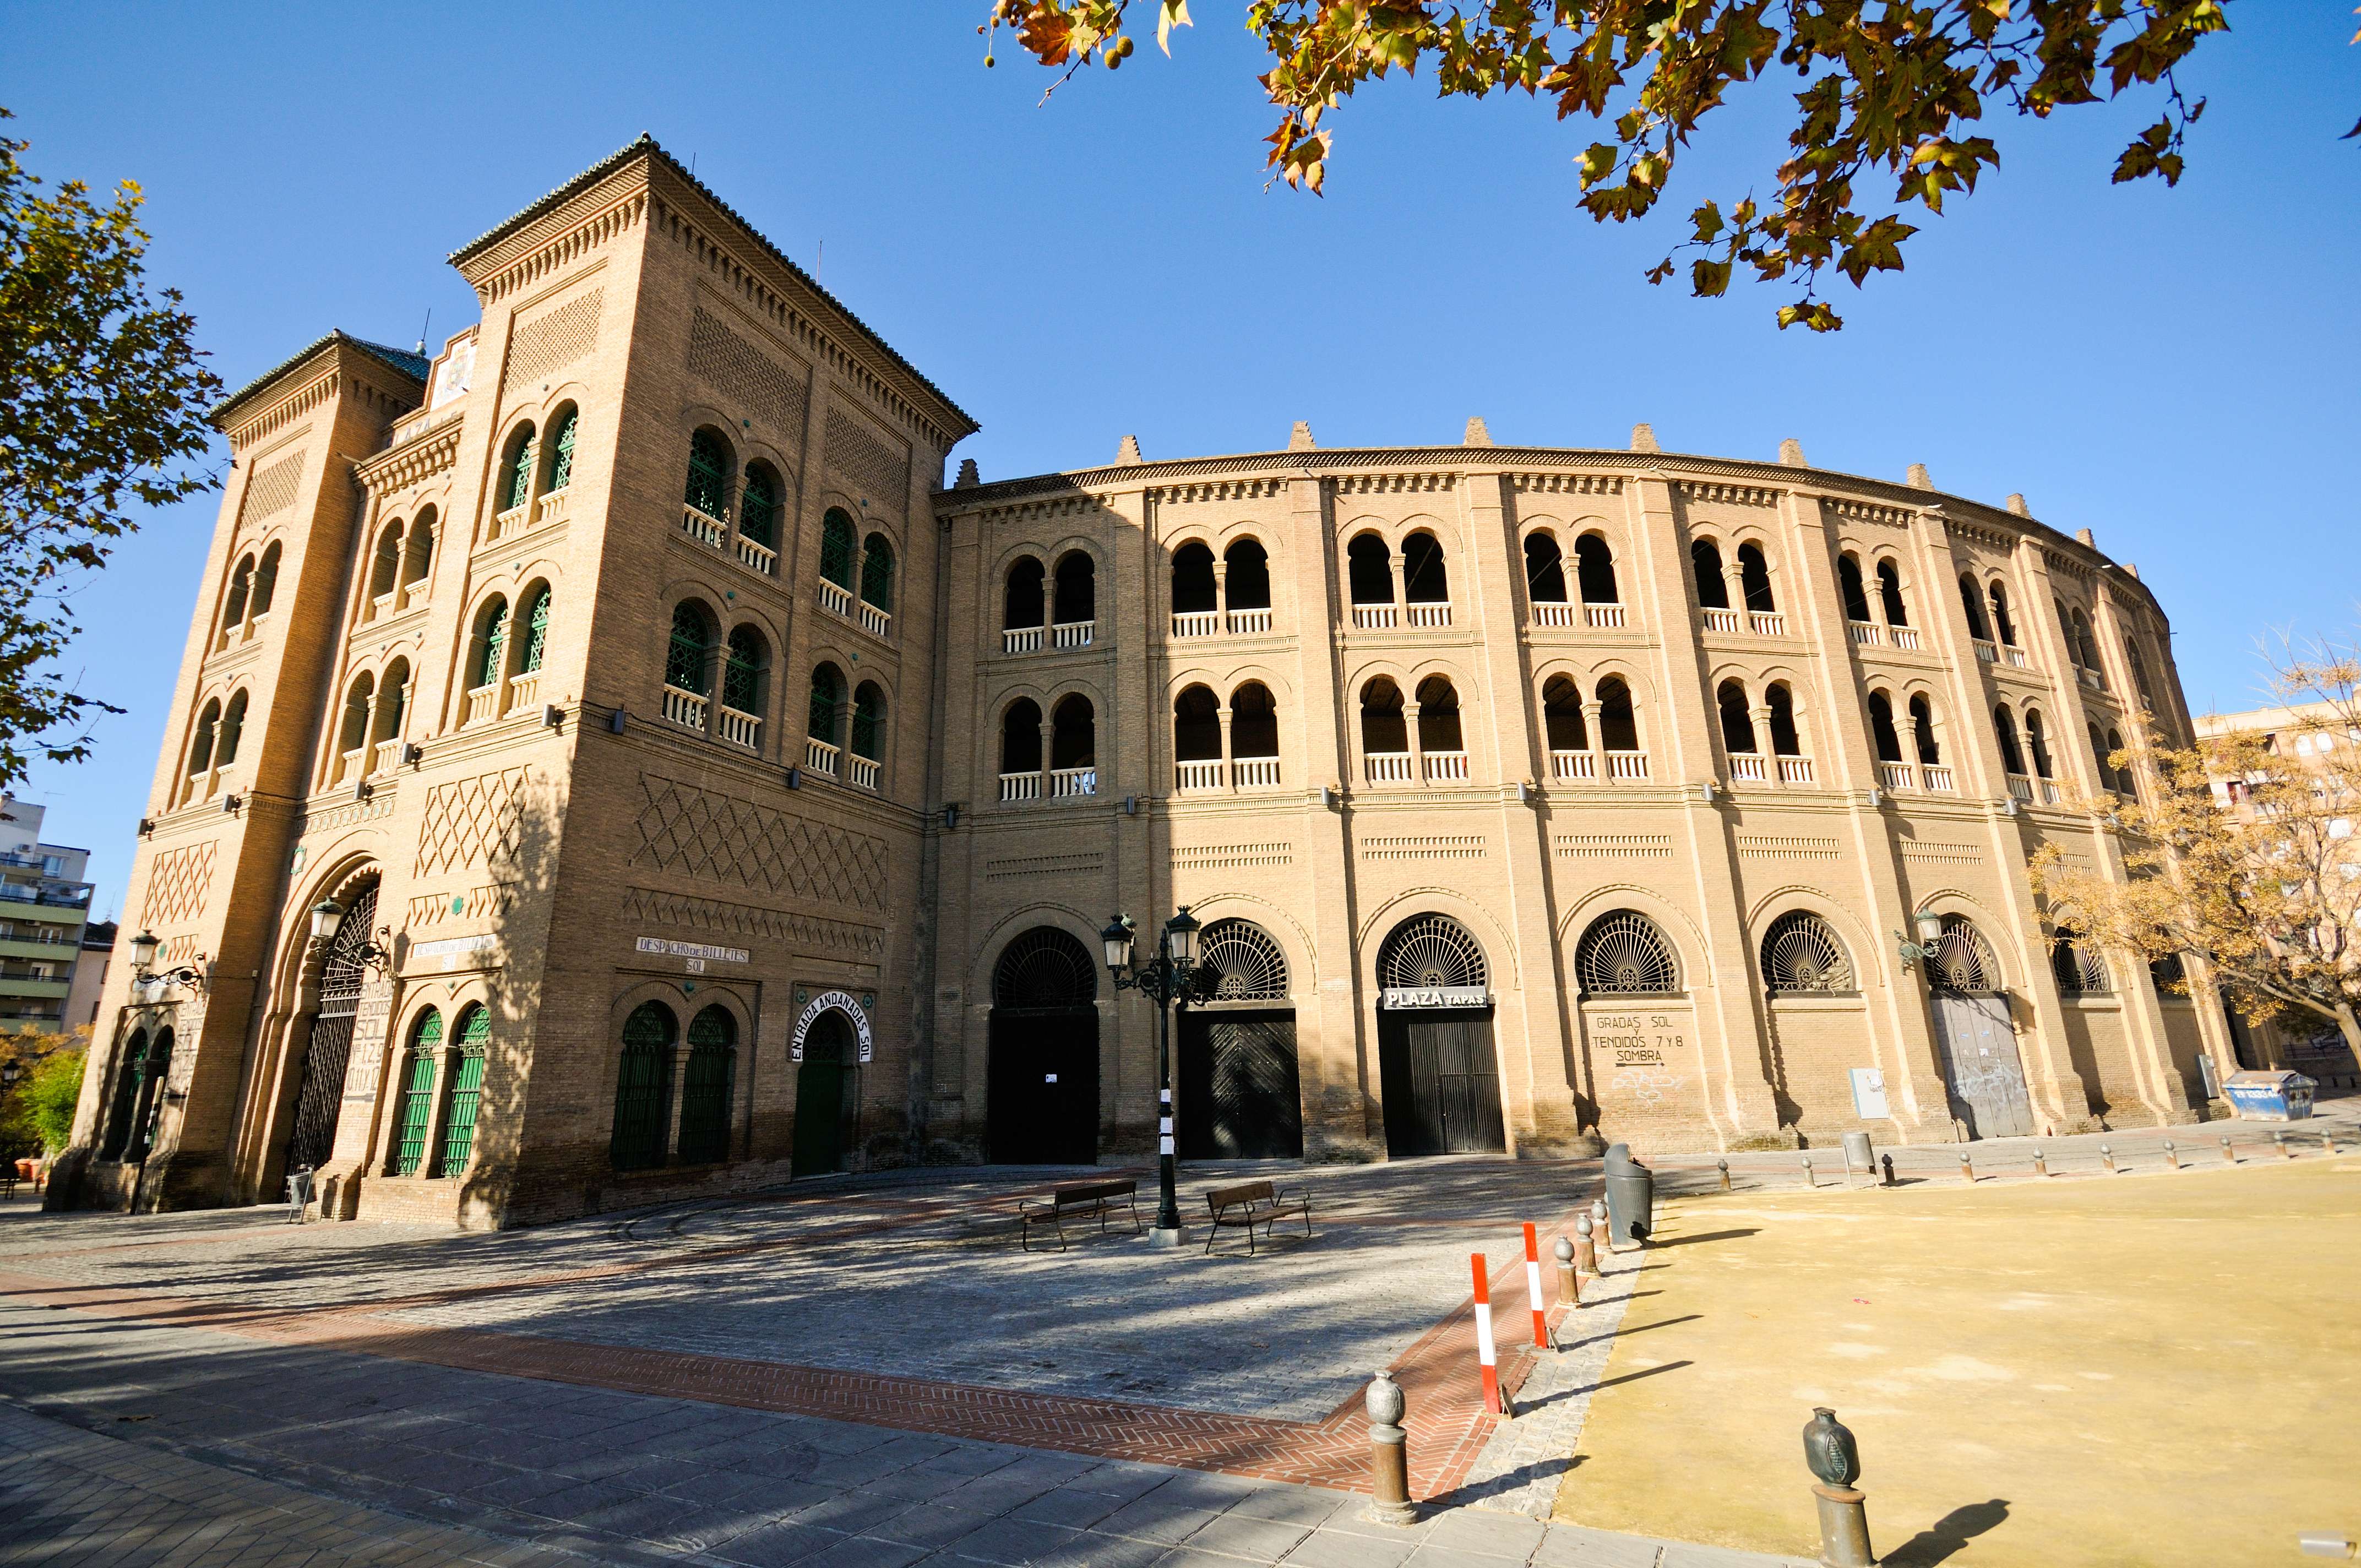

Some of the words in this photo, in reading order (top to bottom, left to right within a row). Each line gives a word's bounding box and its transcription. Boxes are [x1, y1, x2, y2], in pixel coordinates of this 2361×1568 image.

[416, 941, 449, 956] DESPACHO
[449, 943, 458, 952] DE
[458, 935, 494, 951] BILLETES
[640, 938, 689, 955] DESPACHO
[689, 948, 701, 956] DE
[702, 940, 746, 961] BILLETES
[687, 960, 703, 972] SOL
[361, 979, 393, 999] ENTRADA
[1387, 991, 1443, 1006] PLAZA
[1446, 994, 1484, 1005] TAPAS
[358, 999, 391, 1018] TENDIDOS
[353, 1017, 385, 1041] SOL
[792, 1004, 819, 1060] ENTRADA
[819, 993, 868, 1032] ANDANADAS
[860, 1036, 870, 1060] SOL
[1597, 1016, 1641, 1028] GRADAS
[1651, 1016, 1673, 1027] SOL
[1592, 1036, 1646, 1048] TENDIDOS
[1656, 1036, 1663, 1047] 7
[1675, 1036, 1683, 1047] 8
[1617, 1050, 1662, 1061] SOMBRA
